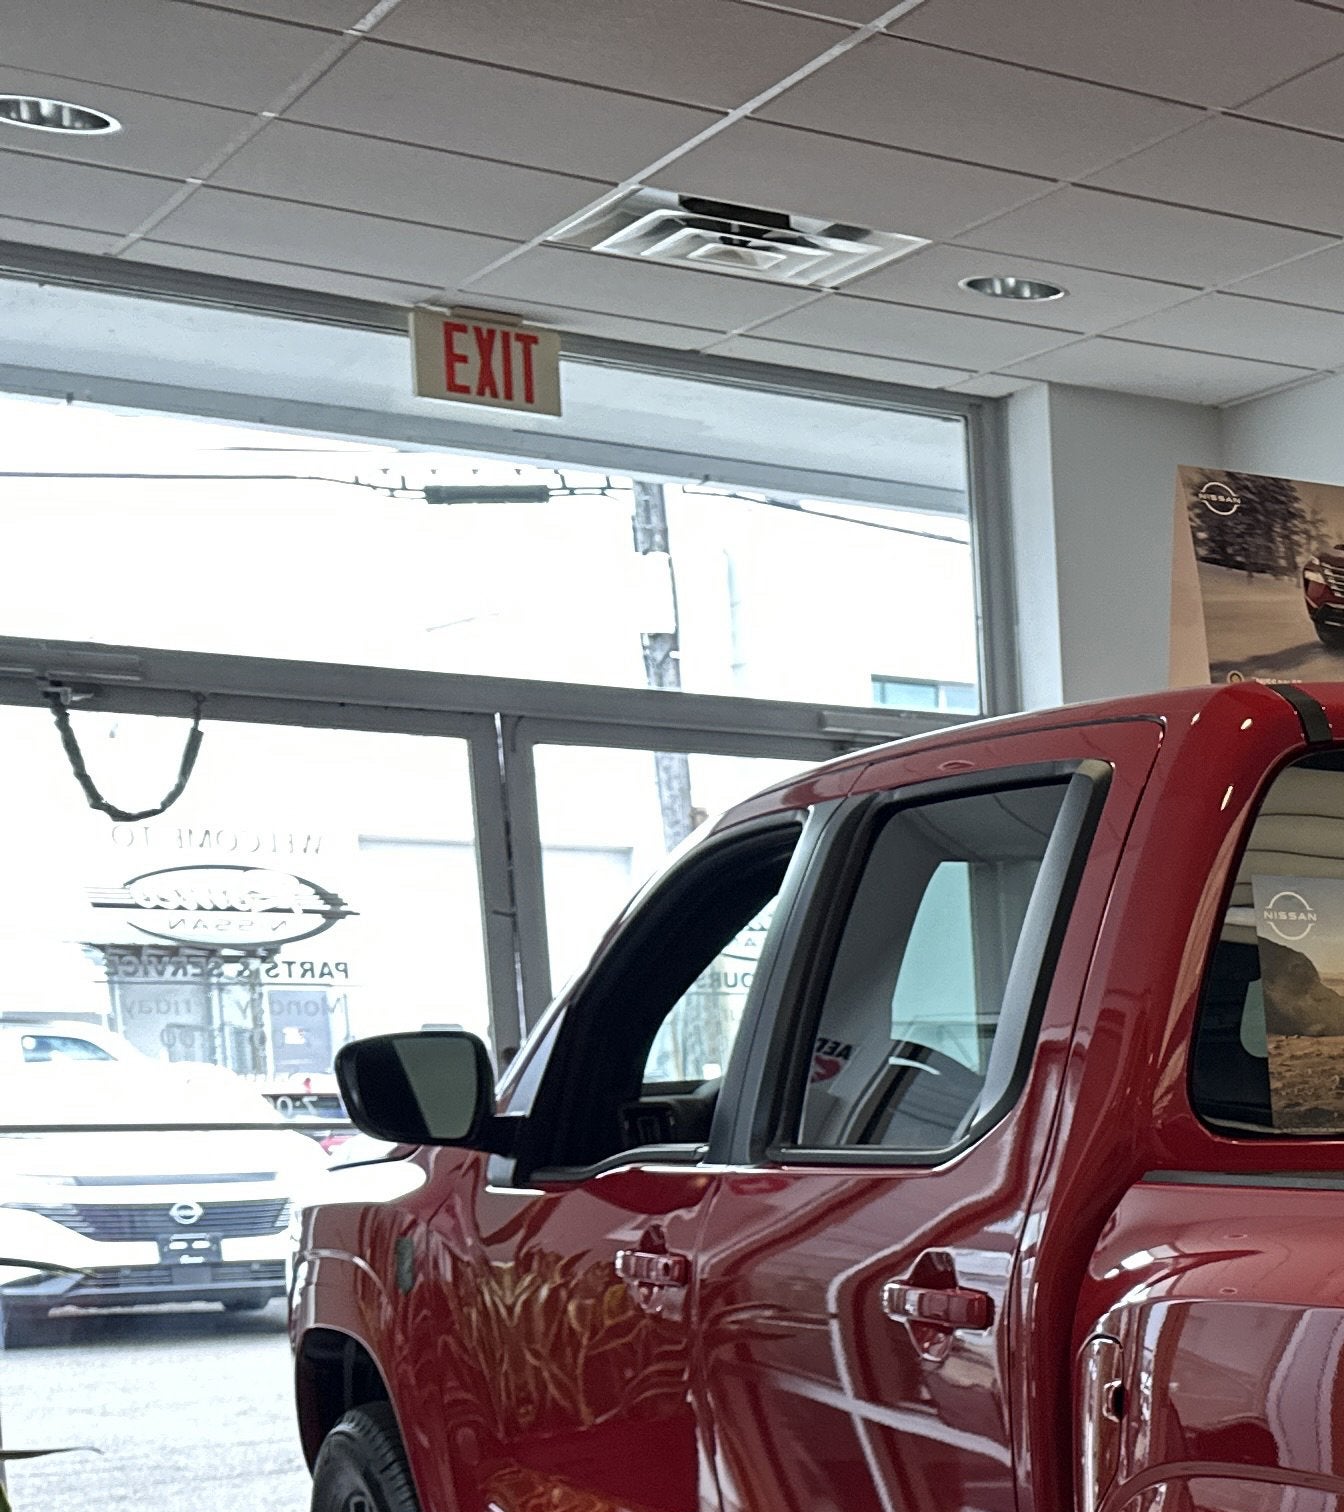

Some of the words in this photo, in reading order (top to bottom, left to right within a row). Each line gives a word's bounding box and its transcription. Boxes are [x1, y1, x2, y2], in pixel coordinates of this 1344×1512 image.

[443, 321, 539, 404] EXIT
[1198, 493, 1241, 504] NISSAN
[1263, 911, 1317, 921] NISSAN
